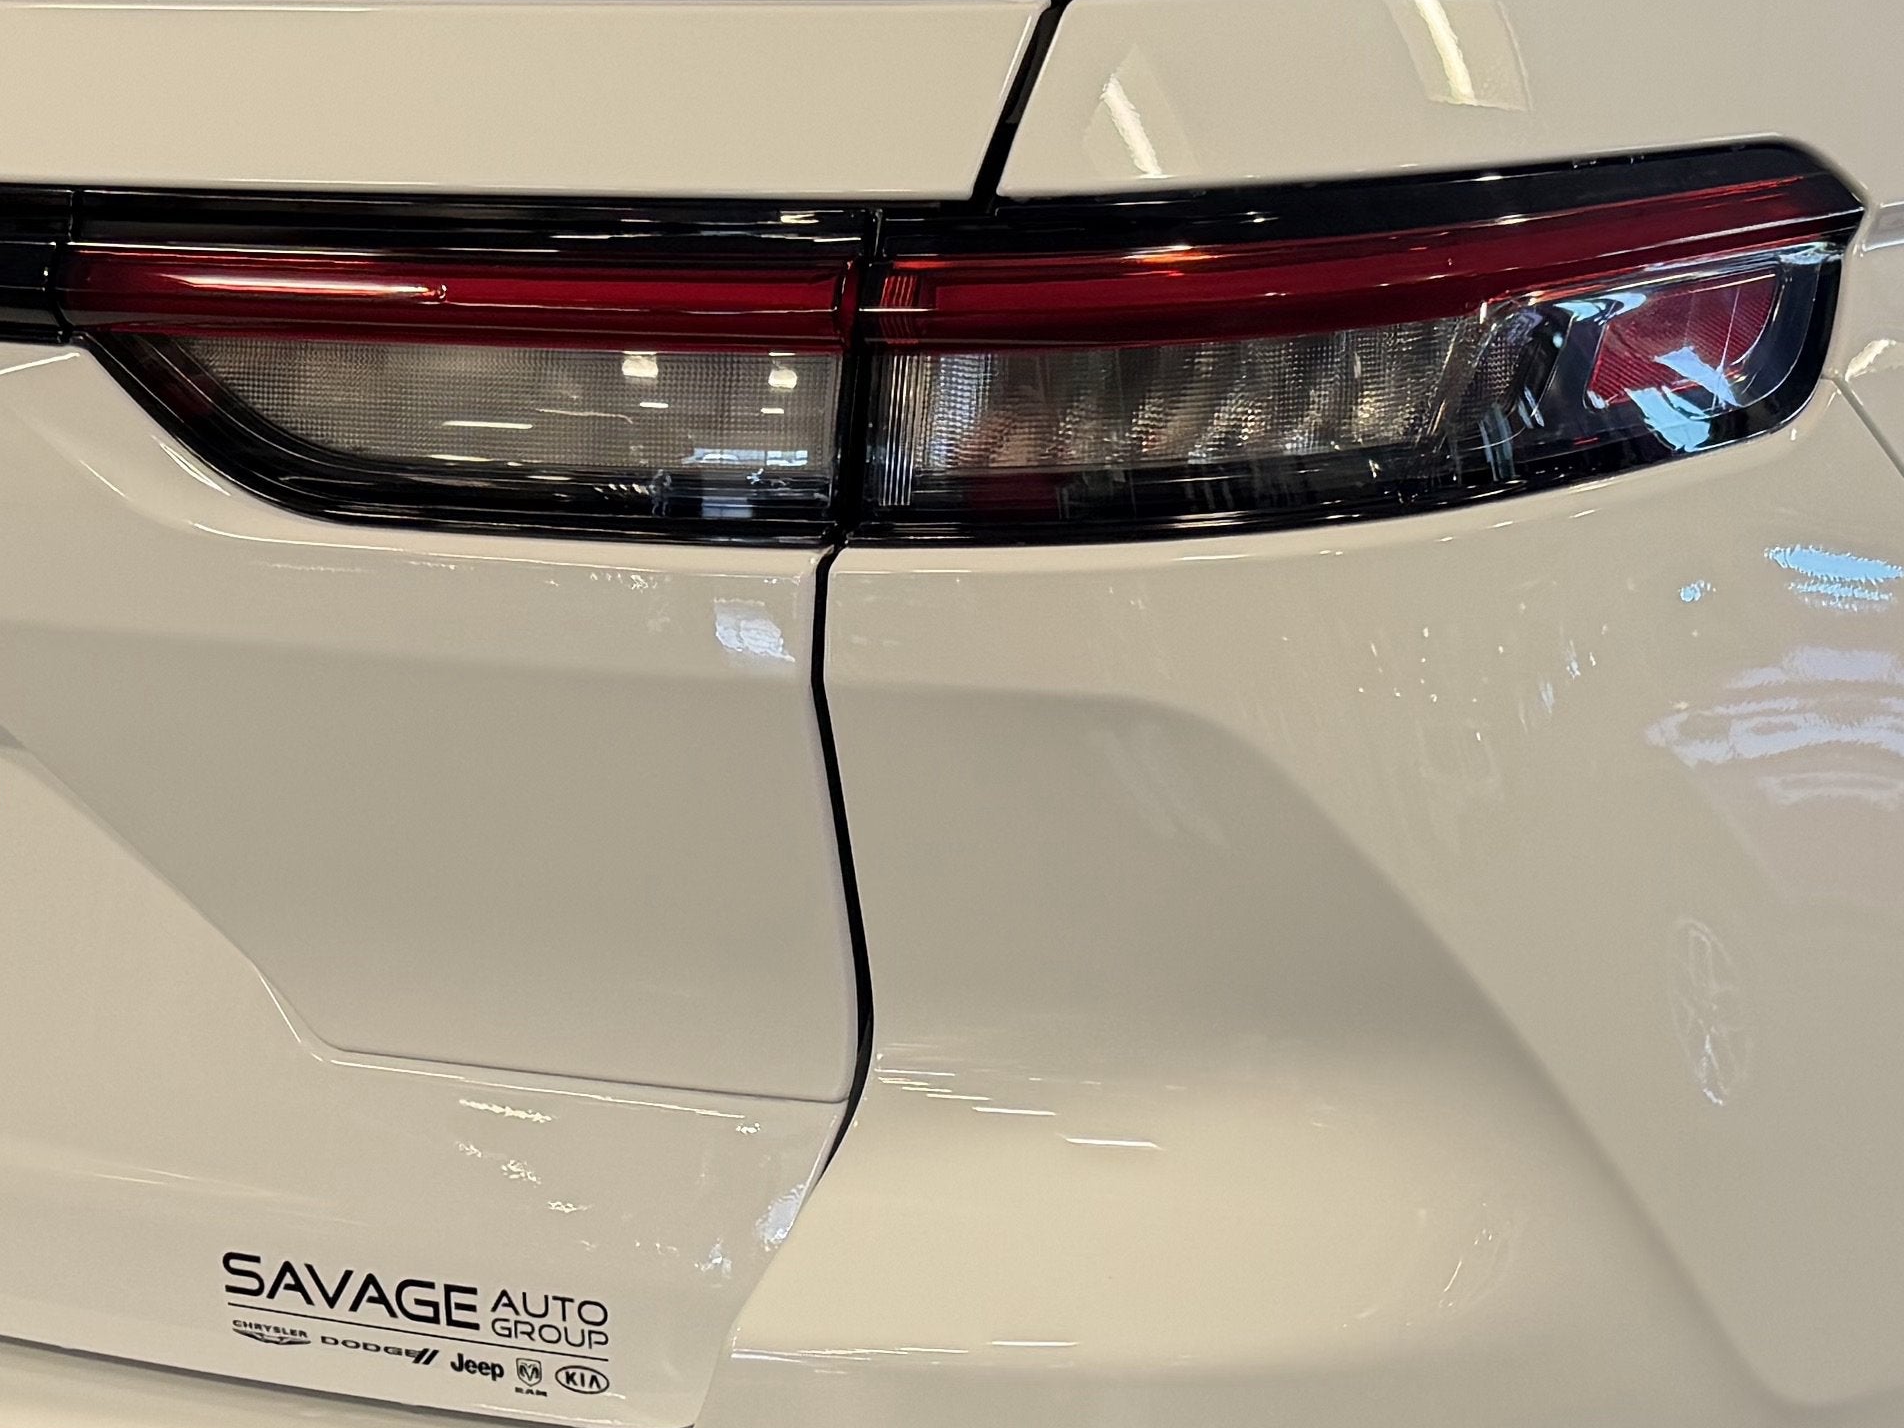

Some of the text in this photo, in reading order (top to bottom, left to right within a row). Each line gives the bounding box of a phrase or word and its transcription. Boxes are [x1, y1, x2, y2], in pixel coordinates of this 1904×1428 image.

[221, 1251, 608, 1332] SAVAGE AUTO
[232, 1319, 309, 1339] CHRYSLER
[320, 1335, 422, 1359] DODGE
[450, 1352, 505, 1382] Jeep
[491, 1317, 609, 1350] GROUP
